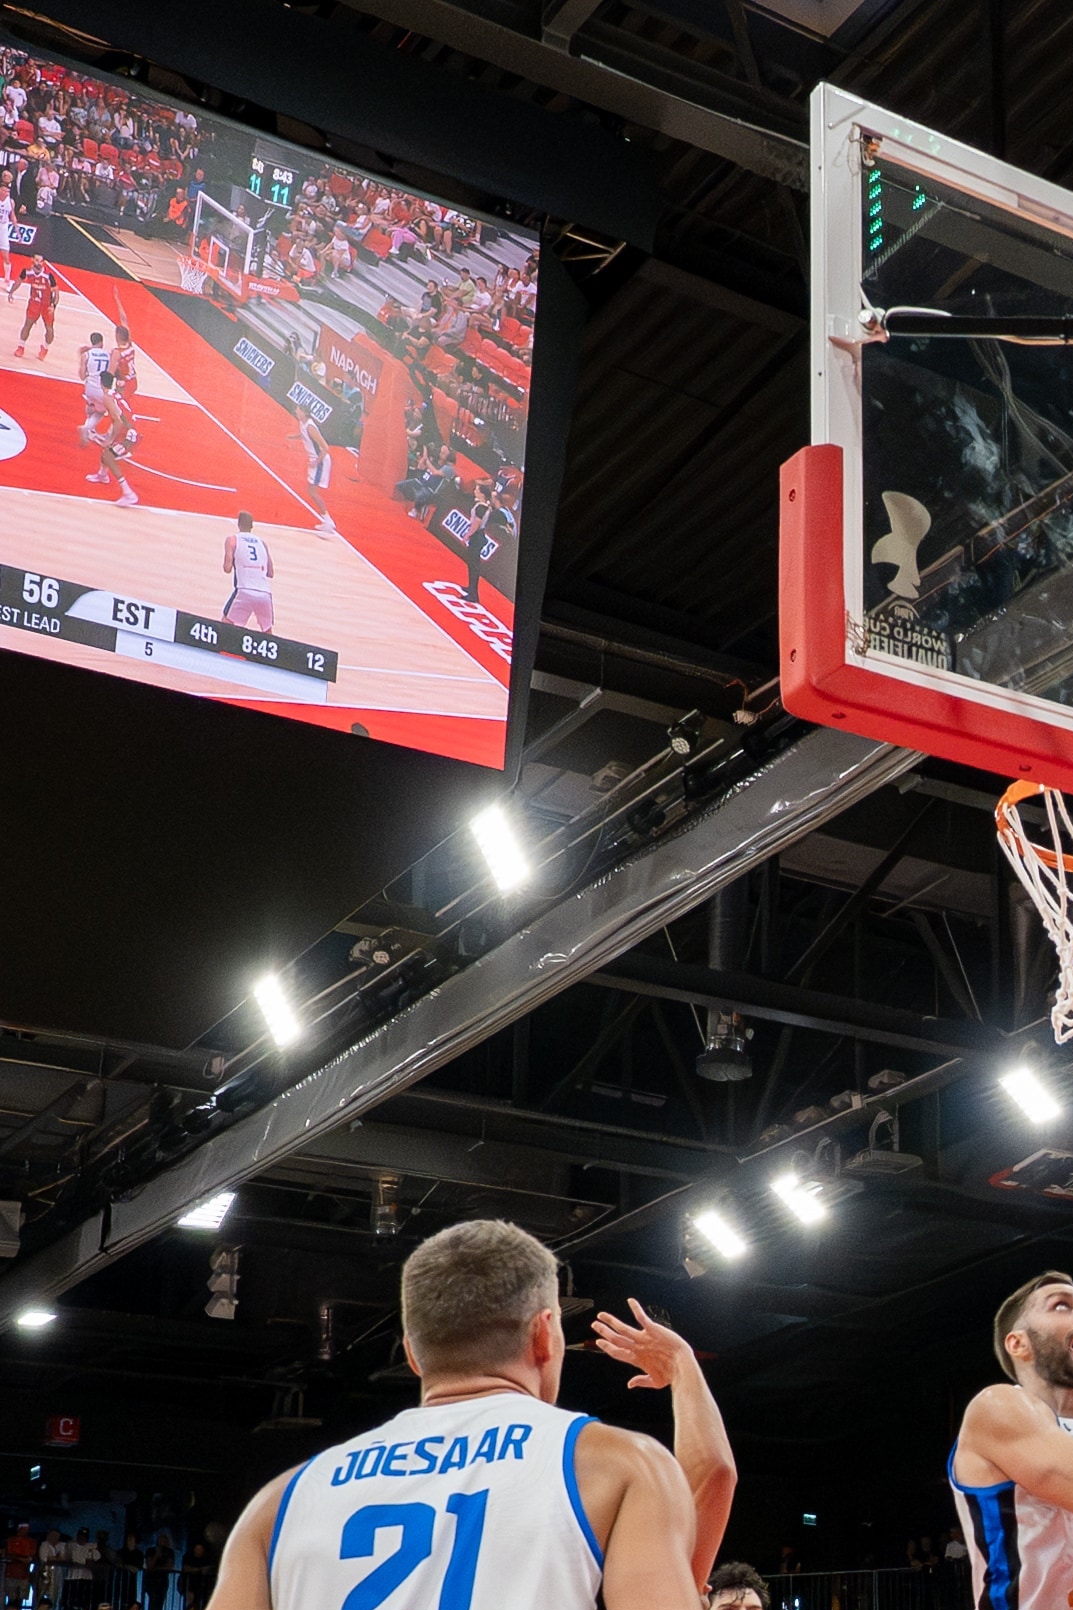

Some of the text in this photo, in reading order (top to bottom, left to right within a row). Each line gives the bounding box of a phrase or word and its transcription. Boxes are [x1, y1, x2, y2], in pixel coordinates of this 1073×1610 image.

[271, 184, 289, 205] 11
[235, 339, 273, 374] SNICKERS
[289, 383, 331, 421] SNICKERS
[247, 545, 258, 562] 3
[22, 572, 60, 609] 56
[23, 611, 61, 633] LEAD
[111, 597, 155, 630] EST
[144, 641, 153, 656] 5
[190, 622, 325, 672] 4th 8:43 12
